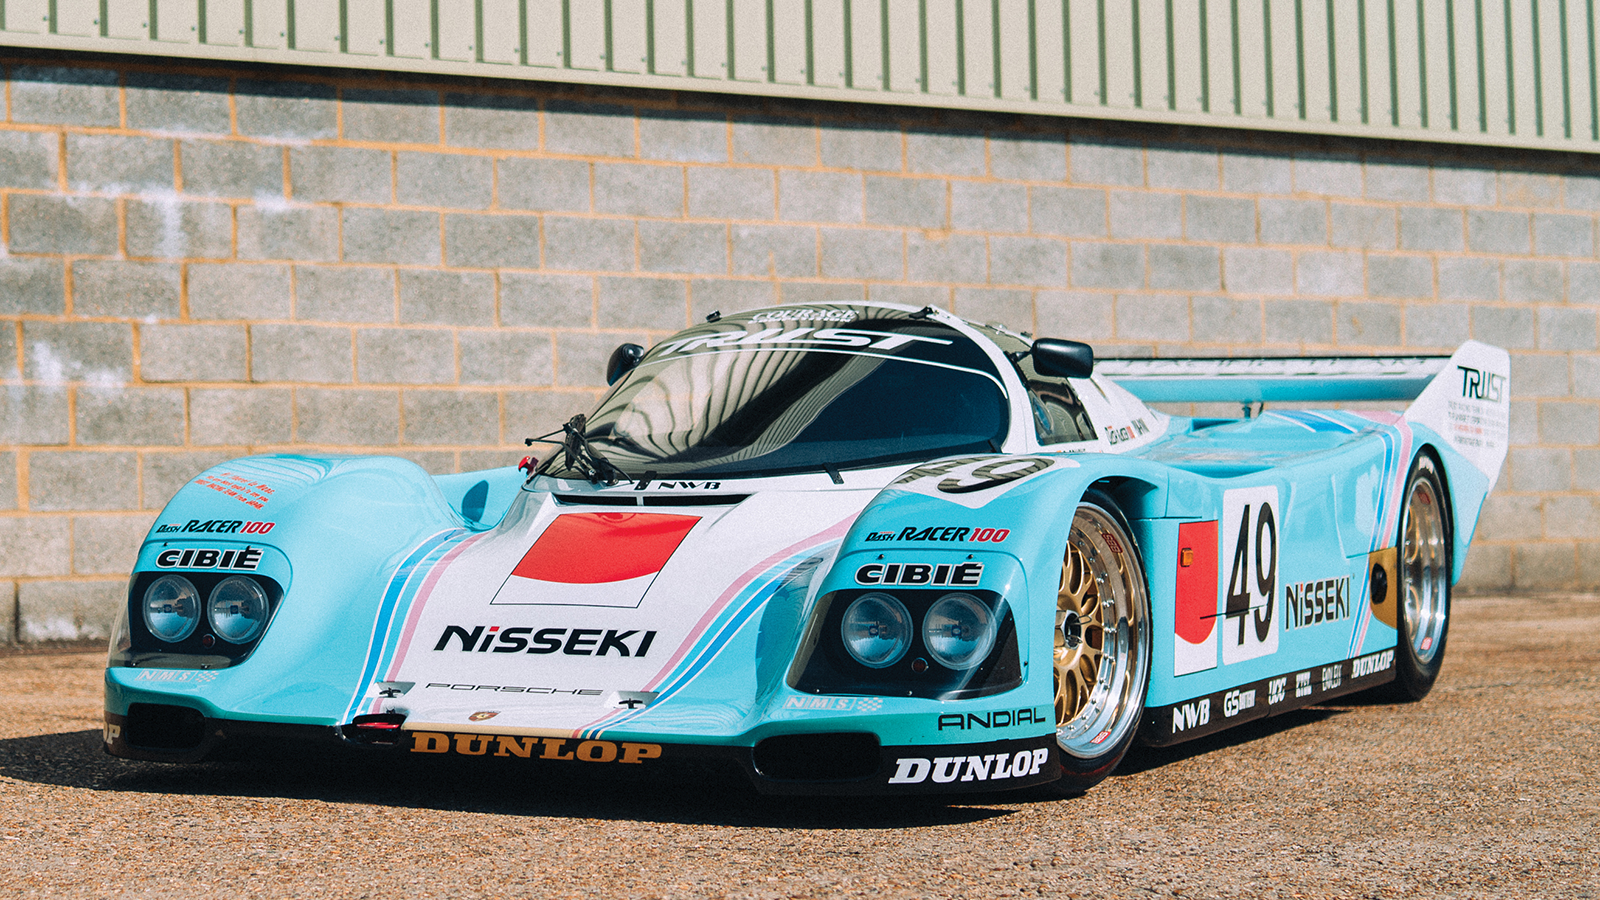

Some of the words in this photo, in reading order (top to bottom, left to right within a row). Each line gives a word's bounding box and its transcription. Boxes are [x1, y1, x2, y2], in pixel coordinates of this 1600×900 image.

[657, 327, 954, 357] TRUST
[1457, 364, 1507, 404] TRUST
[658, 481, 721, 491] NWB
[181, 519, 243, 534] RACER
[239, 521, 276, 535] 100
[865, 532, 896, 542] DASH
[896, 526, 970, 542] RACER
[968, 527, 1011, 543] 100
[156, 548, 264, 571] CIBIÉ
[855, 562, 985, 587] CIBIÉ
[1225, 502, 1277, 646] 49
[1351, 649, 1395, 679] DUNLOP
[425, 682, 604, 696] PORSCHE
[785, 696, 851, 710] NMS
[1172, 698, 1211, 733] NWB
[937, 707, 1047, 731] ANDIAL
[410, 730, 662, 764] DUNLOP
[888, 748, 1048, 785] DUNLOP
